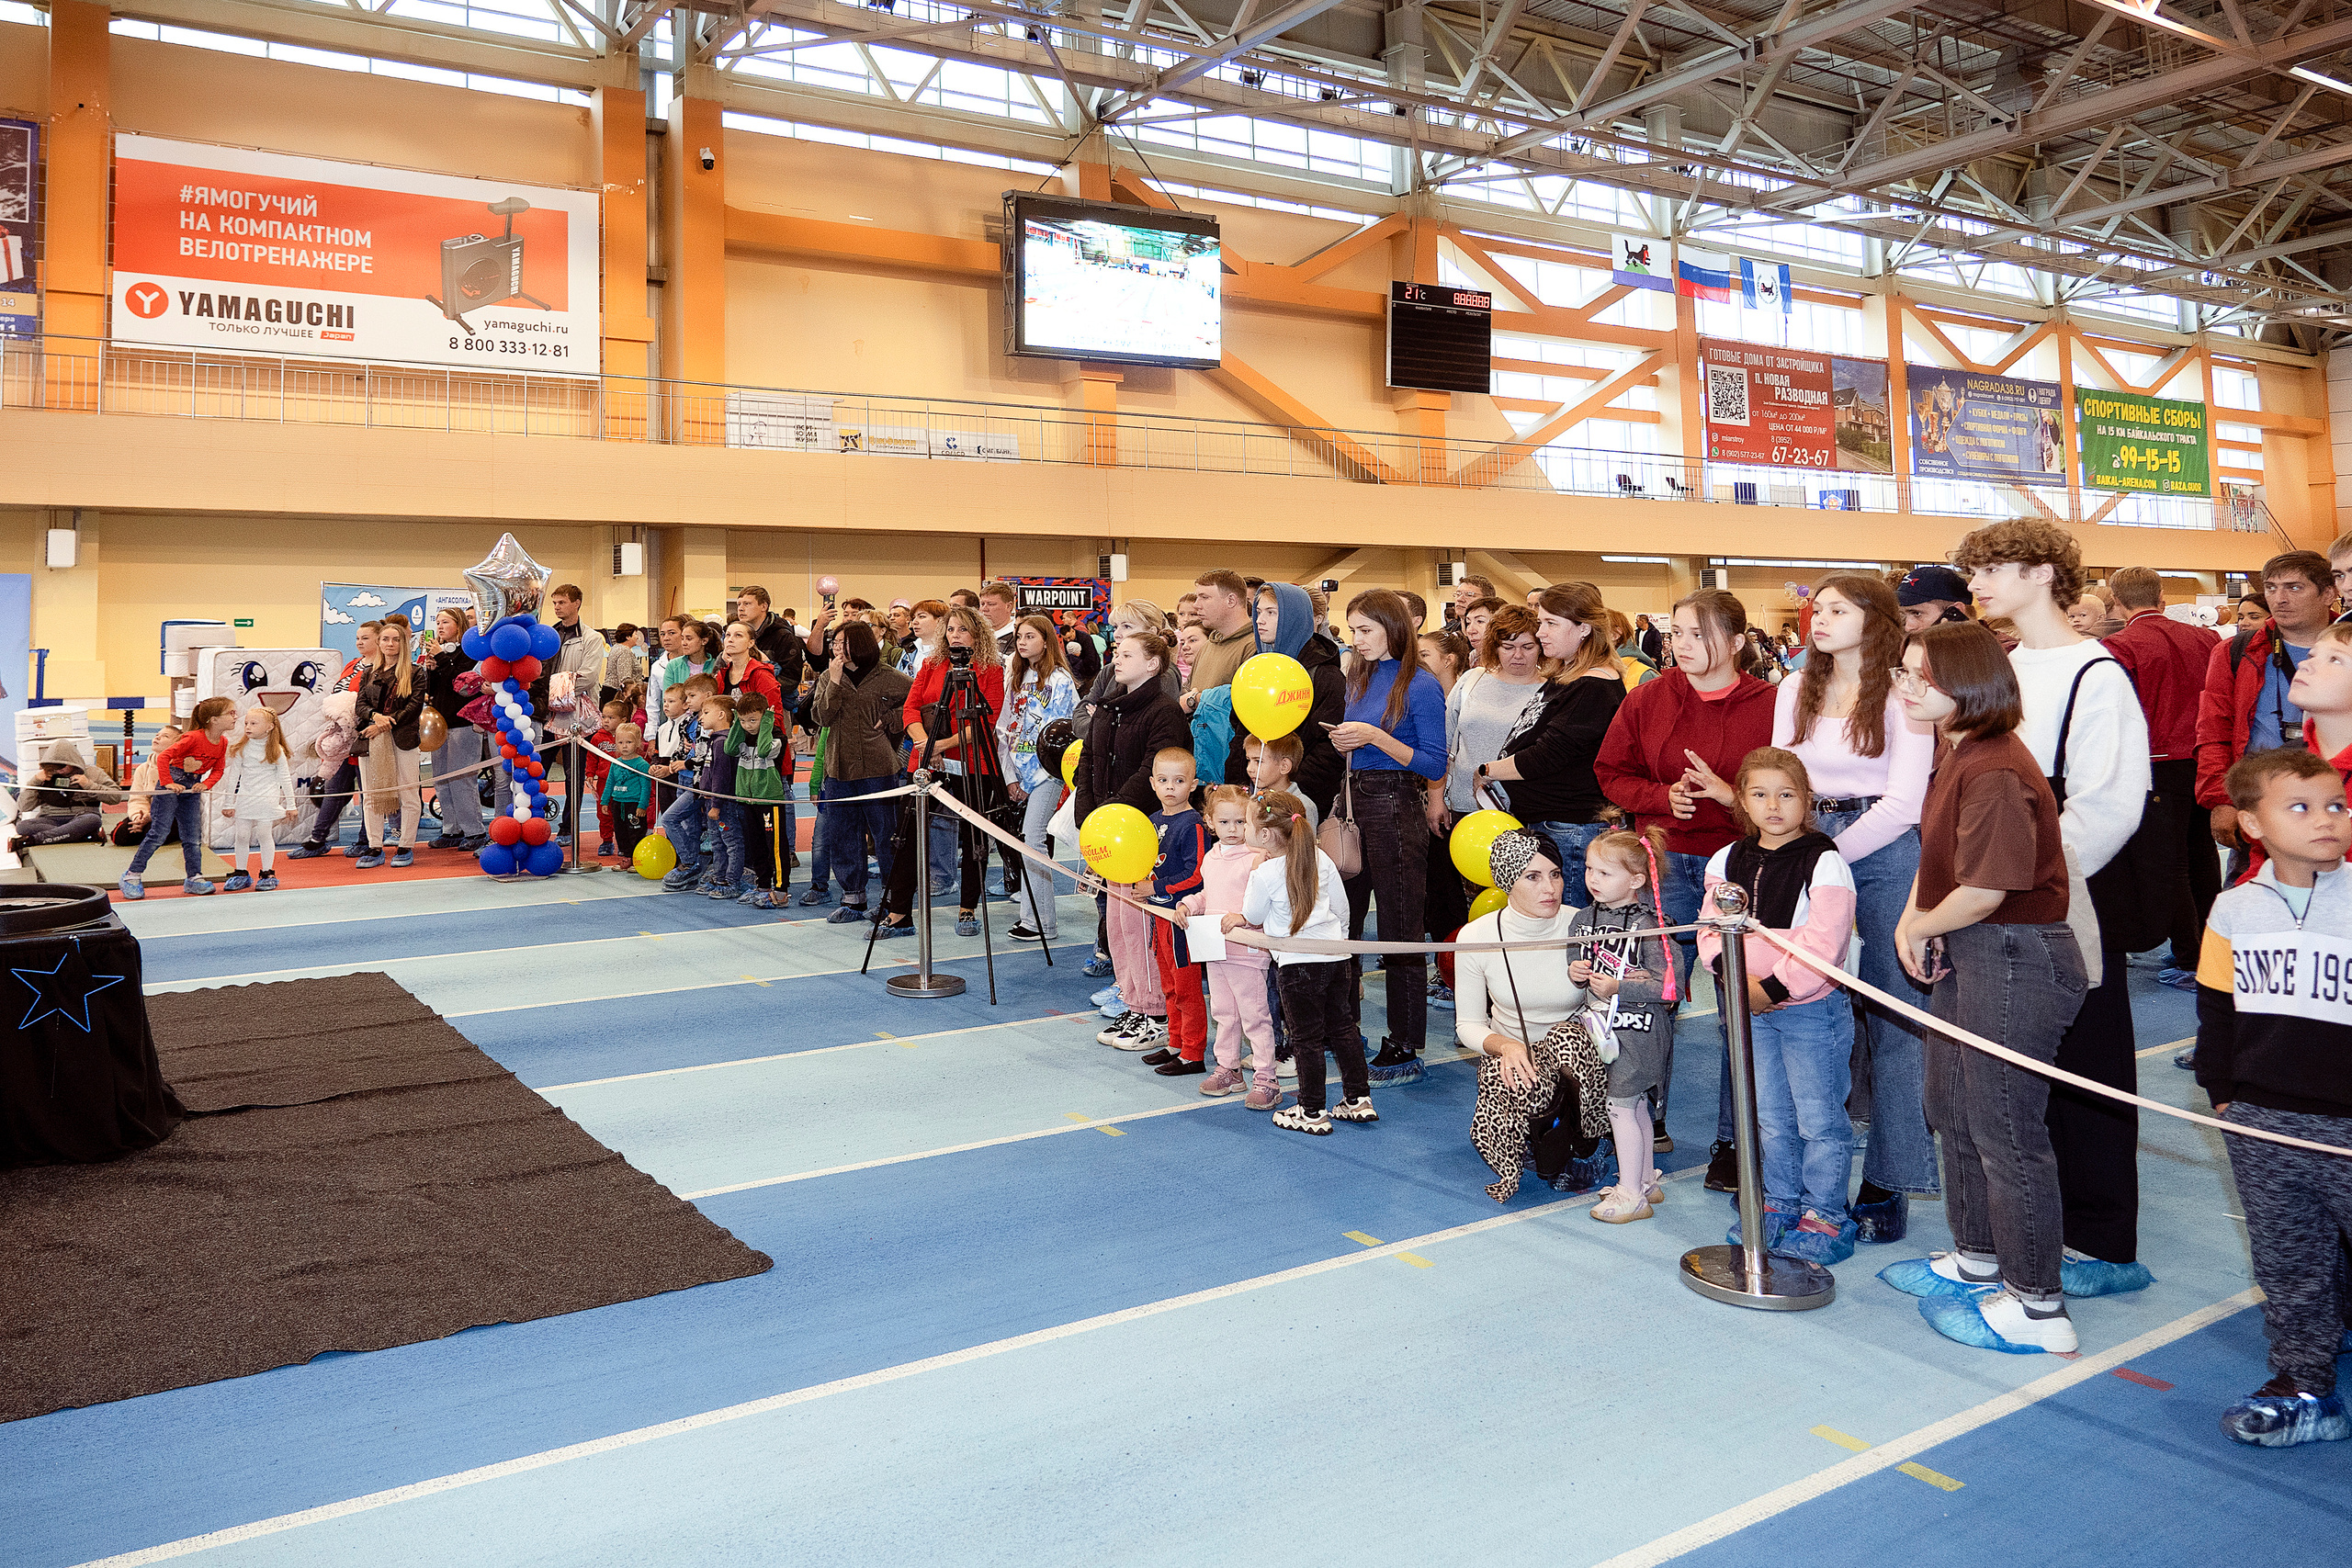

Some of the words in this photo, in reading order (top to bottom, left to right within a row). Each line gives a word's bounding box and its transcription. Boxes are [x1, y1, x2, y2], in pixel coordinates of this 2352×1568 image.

[179, 185, 317, 217] #ЯМОГУЧИЙ
[180, 210, 211, 231] НА
[220, 215, 371, 248] КОМПАКТНОМ
[179, 237, 373, 274] ВЕЛОТРЕНАЖЕРЕ
[1, 298, 16, 307] 14
[178, 290, 355, 329] YAMAGUCHI
[209, 322, 260, 334] ТОЛЬКО
[264, 326, 314, 338] ЛУЧШЕЕ
[484, 320, 569, 333] yamaguchi.ru
[322, 332, 353, 341] Japan
[449, 337, 458, 349] 8
[464, 338, 494, 352] 800
[1709, 348, 1741, 364] ГОТОВЫЕ
[1744, 353, 1764, 367] ДОМА
[1765, 355, 1774, 367] ОТ
[1776, 357, 1825, 374] ЗАСТРОЙЩИКА
[1764, 373, 1790, 387] НОВАЯ
[1966, 378, 2025, 396] NAGRADA38.RU
[1774, 387, 1828, 406] РАЗВОДНАЯ
[2084, 398, 2161, 424] СПОРТИВНЫЕ
[2163, 408, 2201, 429] СБОРЫ
[1769, 423, 1785, 432] ЦЕНА
[2097, 424, 2107, 435] НА
[2108, 426, 2115, 436] 15
[2116, 427, 2126, 438] КМ
[2127, 427, 2175, 443] БАЙКАЛЬСКОГО
[2176, 434, 2197, 446] ТРАКТА
[1772, 446, 1829, 466] 67-23-67
[2120, 445, 2181, 473] 99-15-15
[1024, 590, 1086, 605] WARPOINT
[2233, 949, 2297, 996] SINCE
